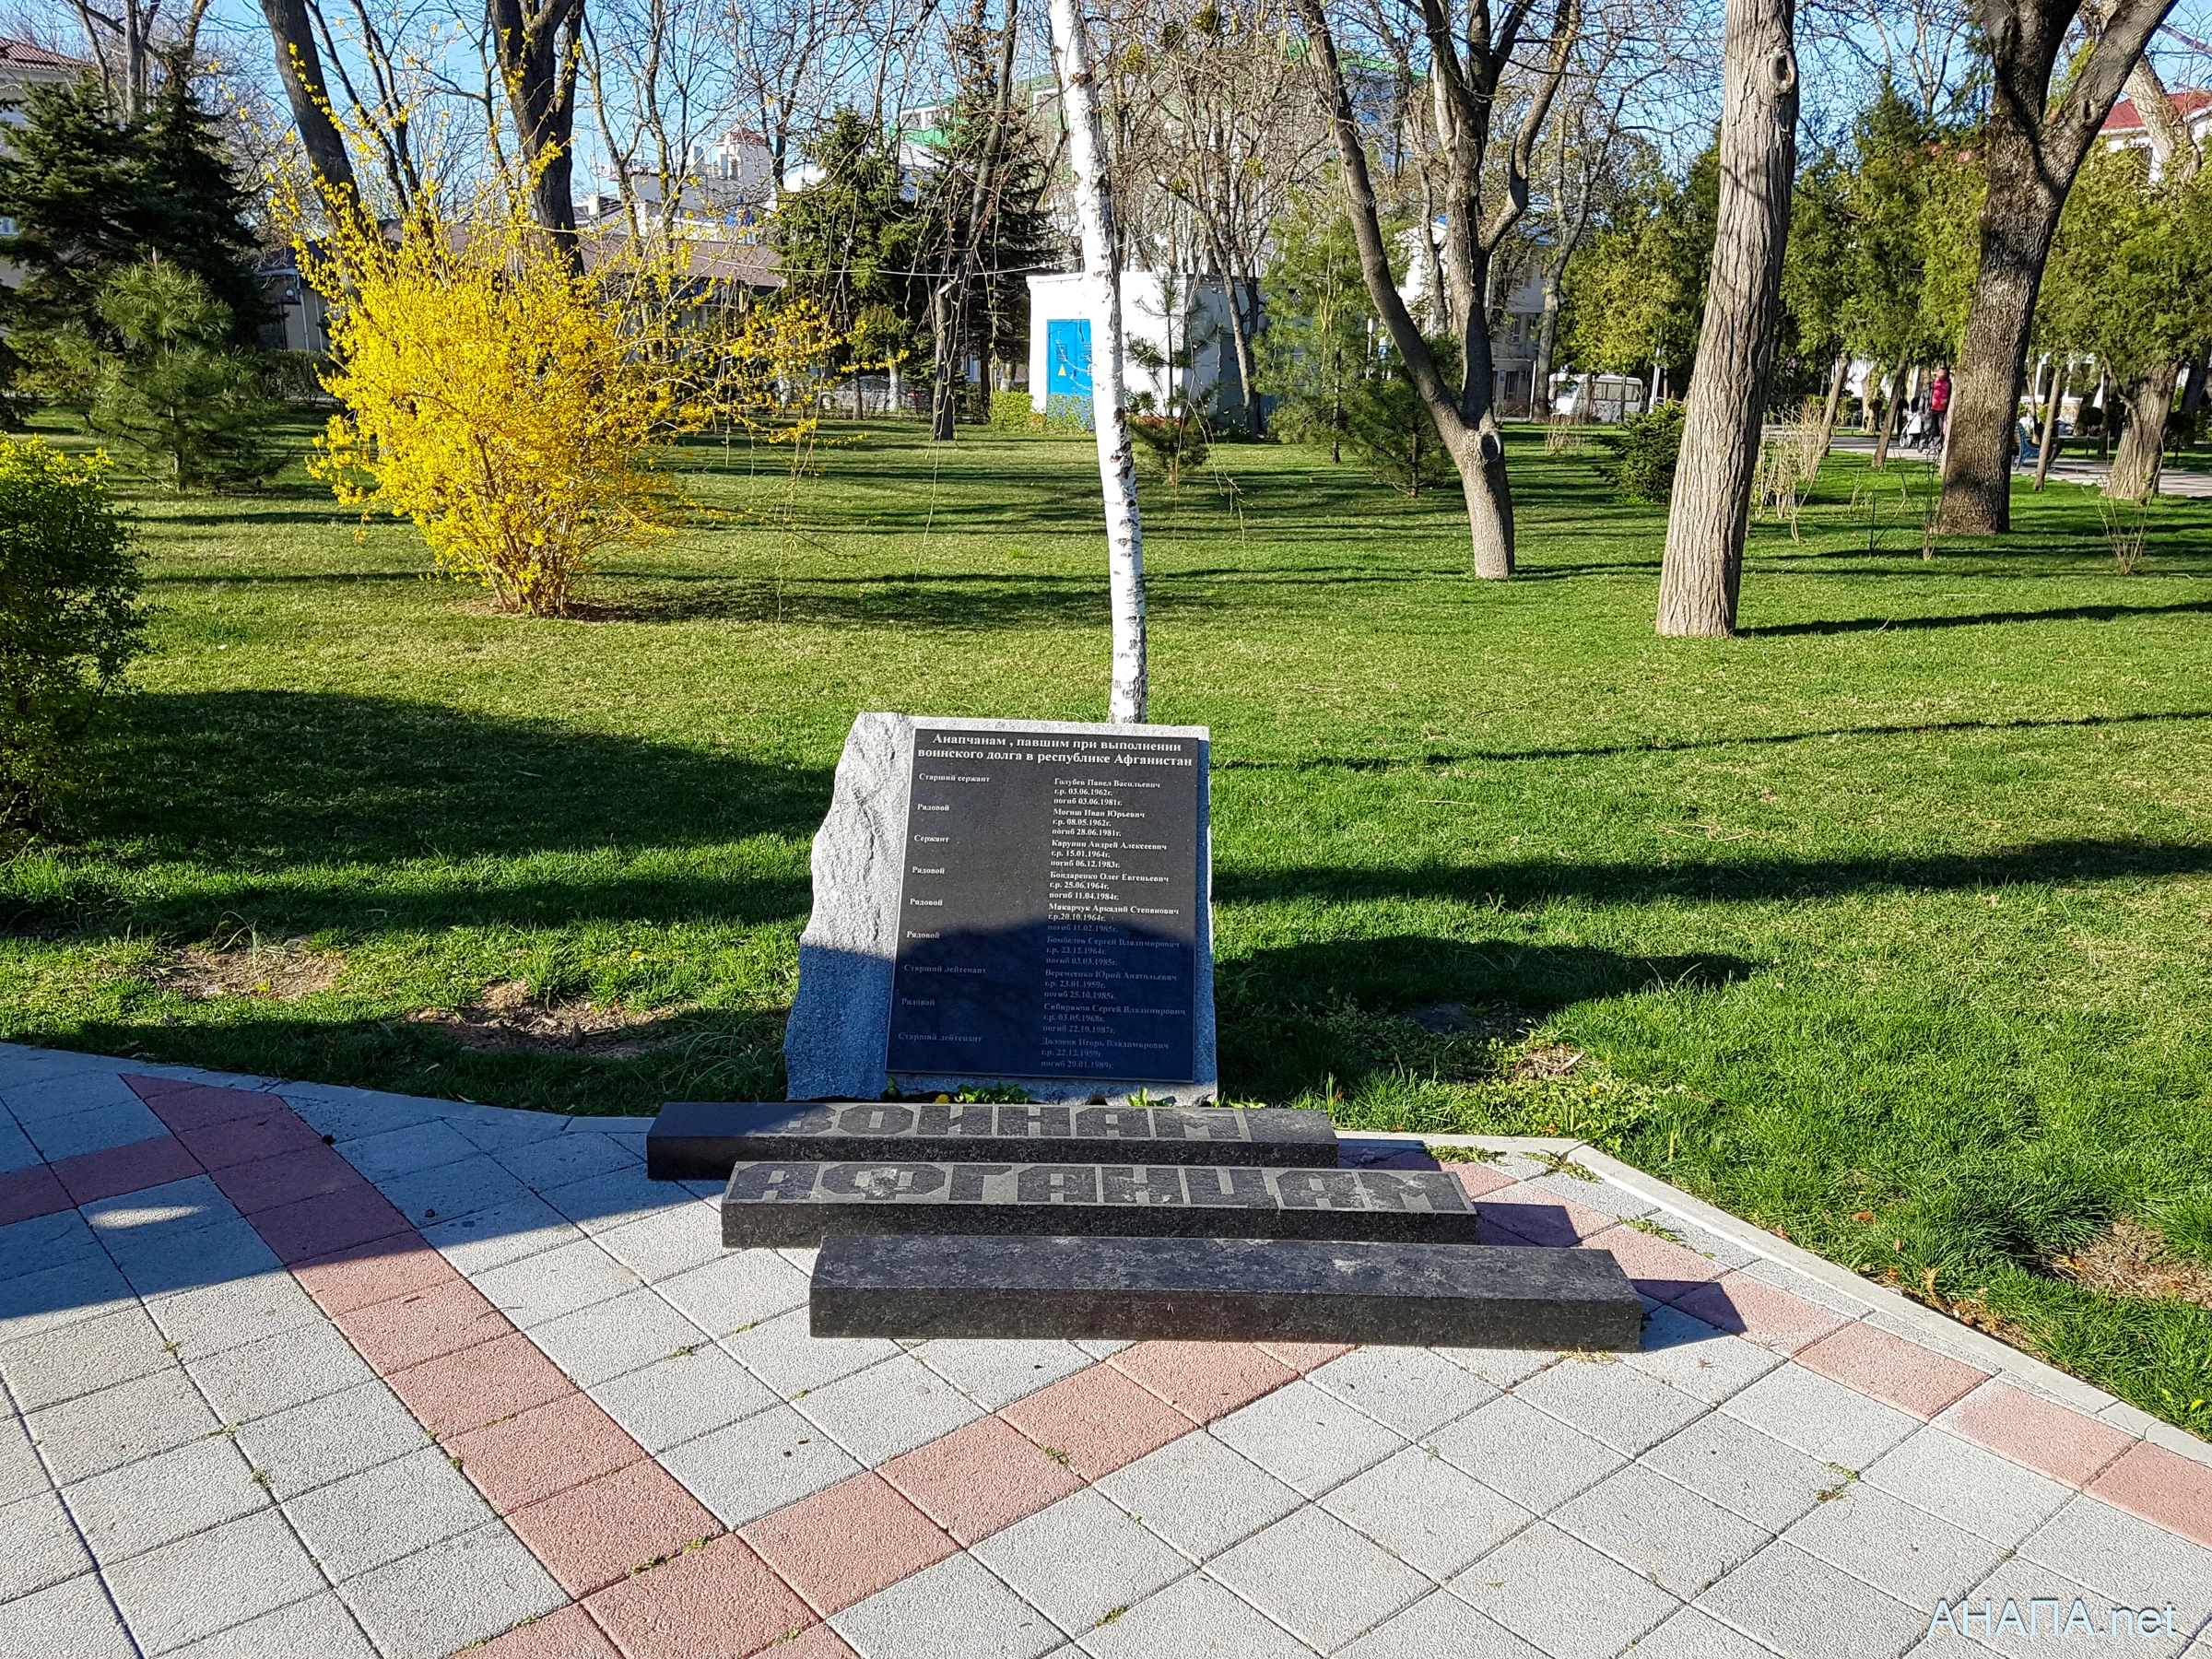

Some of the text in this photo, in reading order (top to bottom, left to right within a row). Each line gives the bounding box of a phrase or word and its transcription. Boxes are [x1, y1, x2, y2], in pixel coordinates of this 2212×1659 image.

[933, 734, 1006, 746] Анапчанам
[1017, 738, 1071, 749] павшим
[1073, 739, 1097, 752] при
[1100, 741, 1181, 752] выполнении
[918, 747, 1193, 767] воинского долга в республике Афганистан
[919, 772, 955, 782] Старший
[1054, 778, 1160, 788] Голубев Павел Васильевич
[1054, 788, 1066, 796] г.р.
[917, 804, 949, 812] Рядовой
[1108, 810, 1145, 819] Юрьевич
[1053, 819, 1065, 828] г.р.
[914, 834, 949, 844] Сержант
[1088, 841, 1118, 850] Андрей
[1120, 841, 1167, 851] Алексеевич
[1051, 860, 1074, 868] погиб
[912, 866, 945, 875] Рядовой
[1050, 872, 1169, 883] Бондаренко Олег Евгеньевич
[1049, 892, 1073, 900] погиб
[910, 898, 942, 907] Рядовой
[1048, 903, 1179, 915] Макарчук Аркадий Степанович
[907, 931, 940, 939] Рядовой
[1088, 937, 1117, 947] Сергей
[1120, 938, 1180, 948] Владимирович
[1046, 957, 1070, 965] погиб
[904, 964, 986, 974] Старший лейтенант
[1095, 971, 1120, 980] Юрий
[1123, 971, 1177, 982] Анатольевич
[1044, 990, 1068, 999] погиб
[901, 998, 935, 1006] Рядовой
[1091, 1004, 1121, 1014] Сергей
[1124, 1006, 1185, 1016] Владимирович
[1042, 1024, 1067, 1032] погиб
[898, 1032, 982, 1042] Старший лейтенант
[1078, 1039, 1105, 1048] Игорь
[1107, 1040, 1169, 1049] Владимирович
[1041, 1059, 1065, 1067] погиб
[754, 1105, 1245, 1139] ВОИНАМ
[732, 1163, 1465, 1211] АФГАНЦАМ
